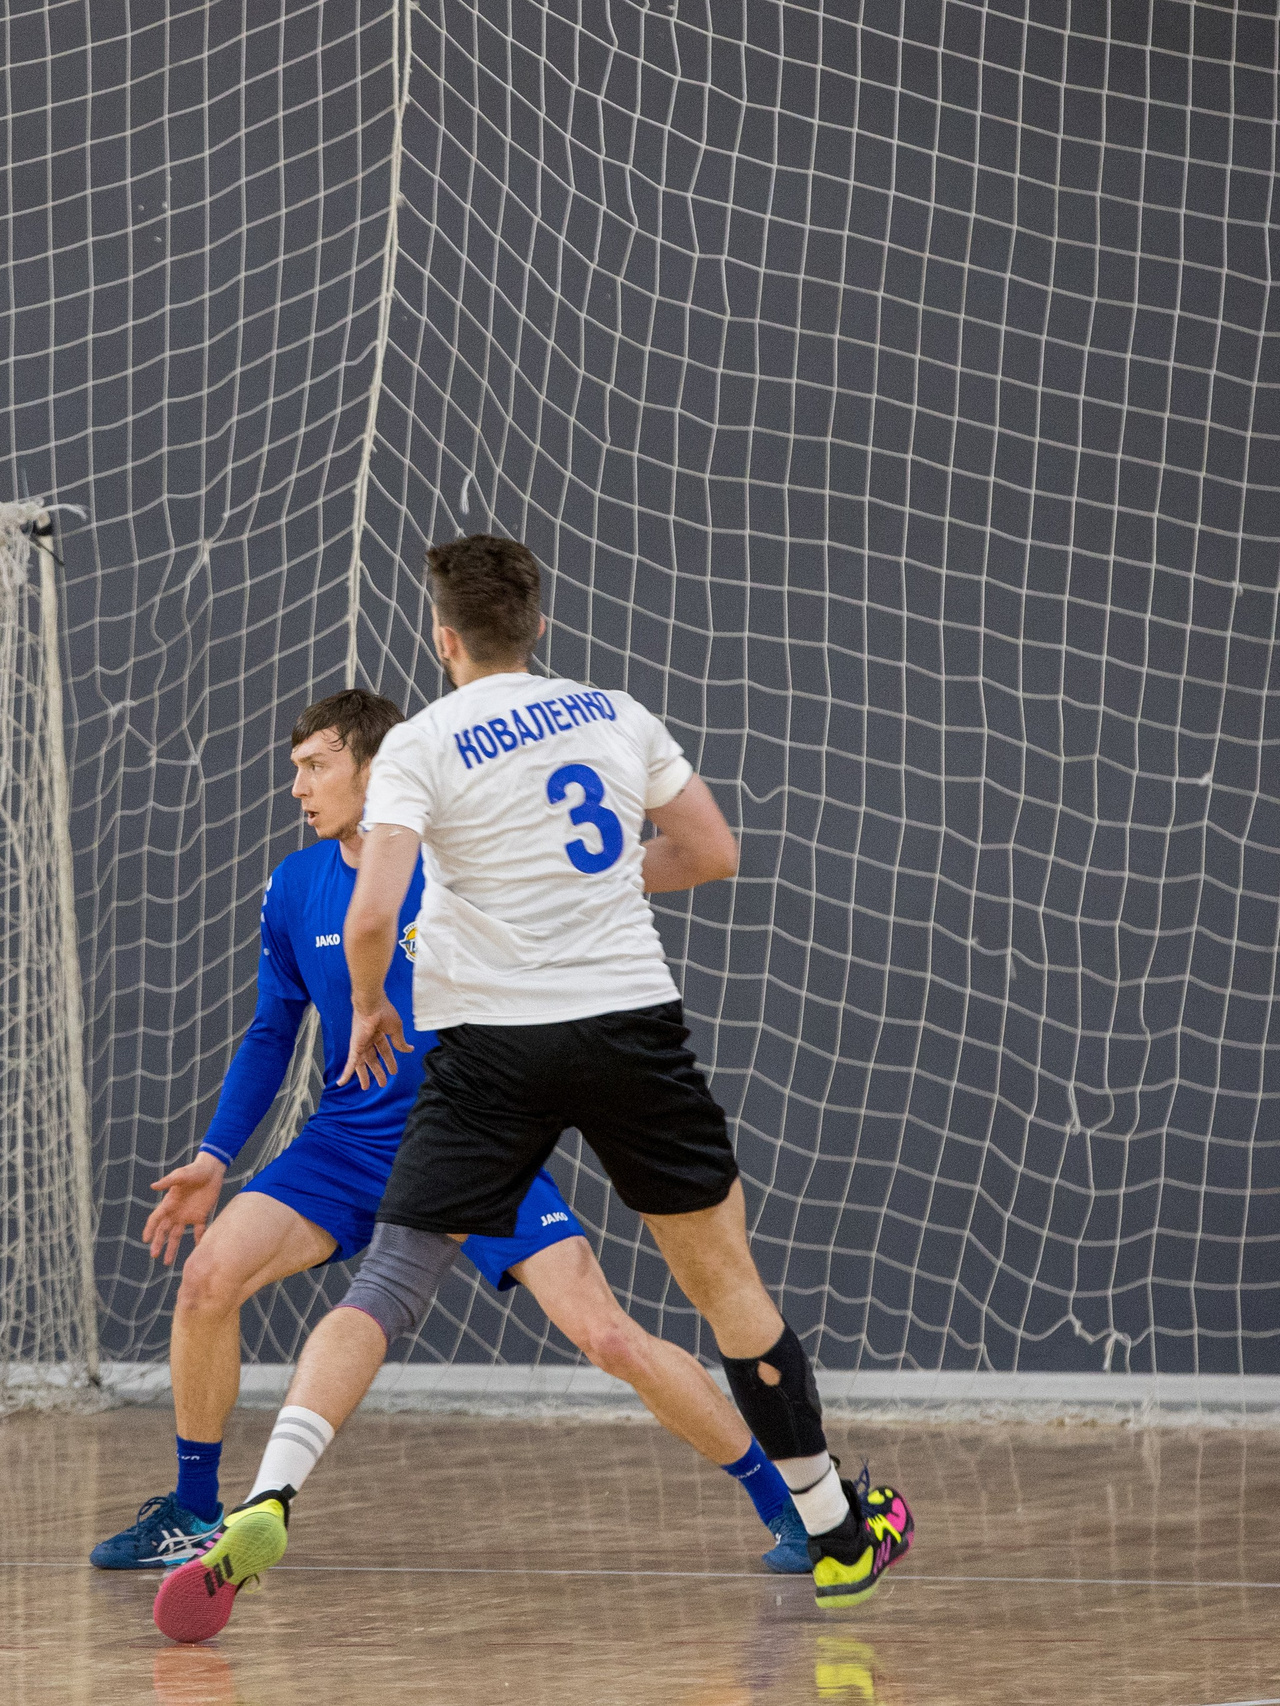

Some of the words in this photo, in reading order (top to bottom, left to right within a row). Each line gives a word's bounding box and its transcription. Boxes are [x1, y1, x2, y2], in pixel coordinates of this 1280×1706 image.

[546, 763, 624, 874] 3
[315, 933, 341, 948] JAKO
[540, 1212, 569, 1227] JAKO
